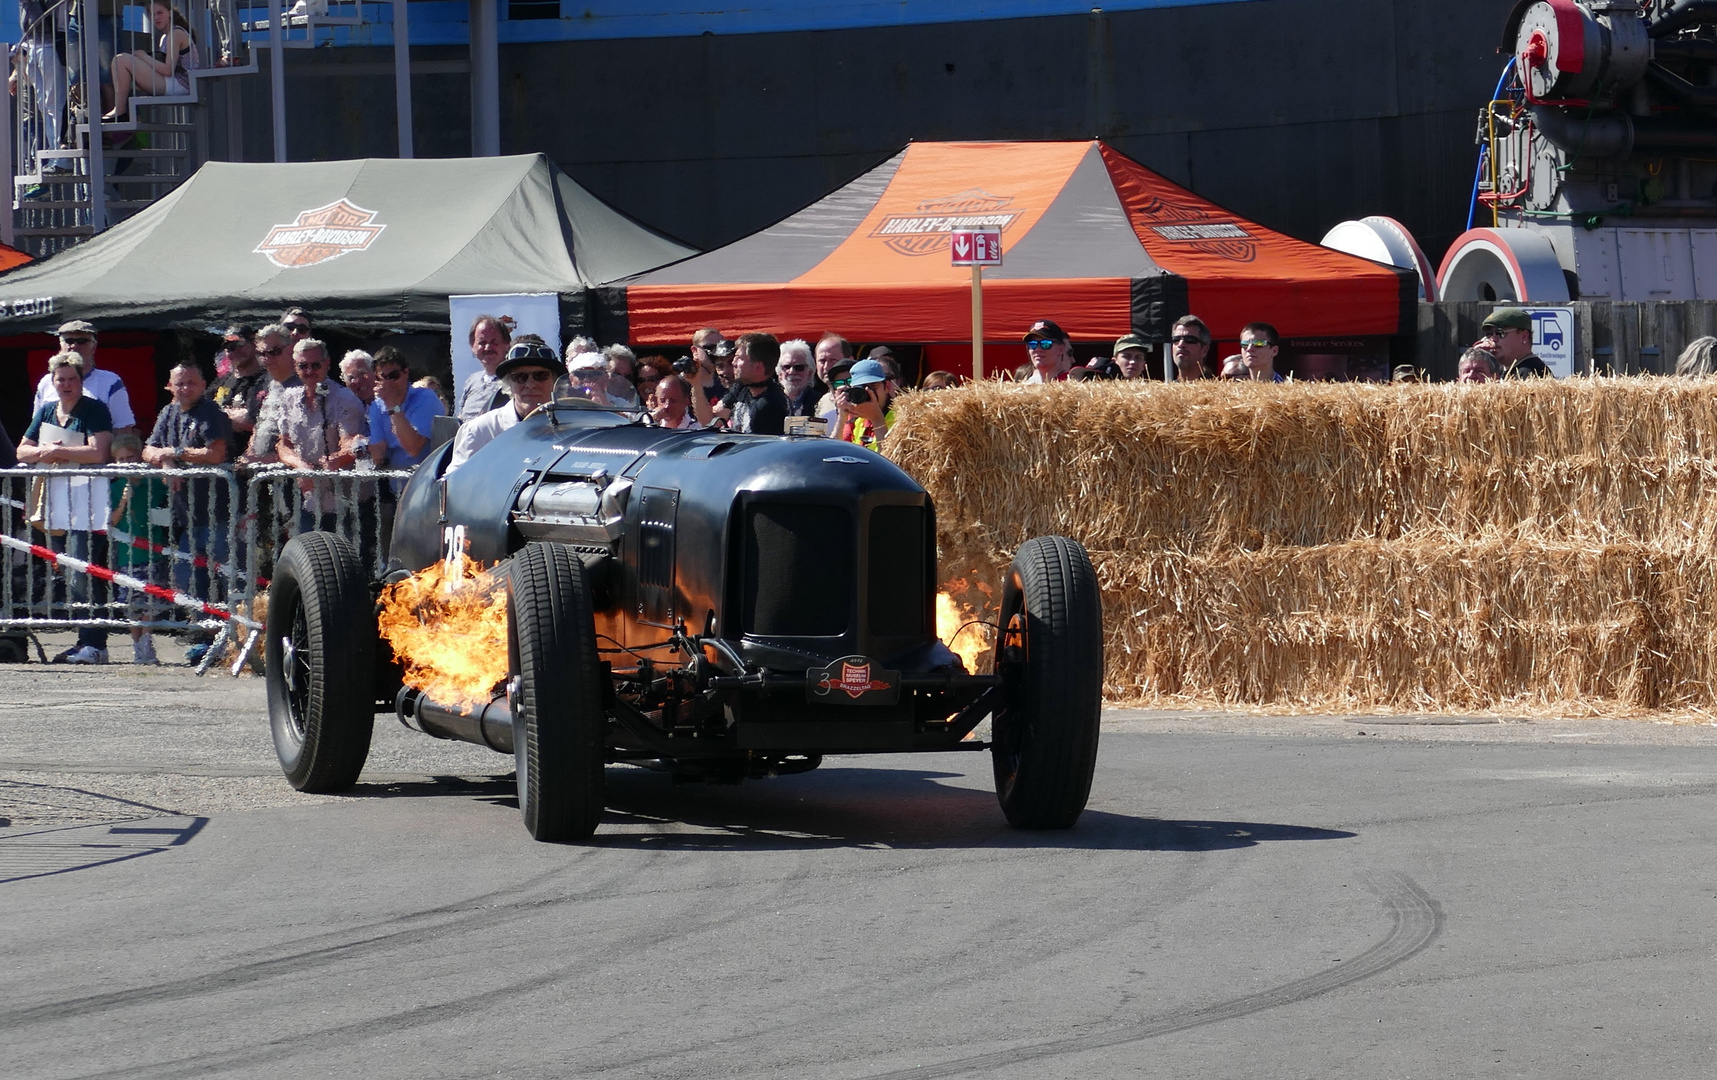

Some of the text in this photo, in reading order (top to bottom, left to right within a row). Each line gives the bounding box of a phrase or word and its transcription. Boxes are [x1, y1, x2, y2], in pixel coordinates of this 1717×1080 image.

[268, 228, 372, 246] HARLEY-DAVIDSON
[444, 524, 465, 594] 28
[814, 672, 831, 696] 3
[839, 683, 871, 691] BRAZZELTAG
